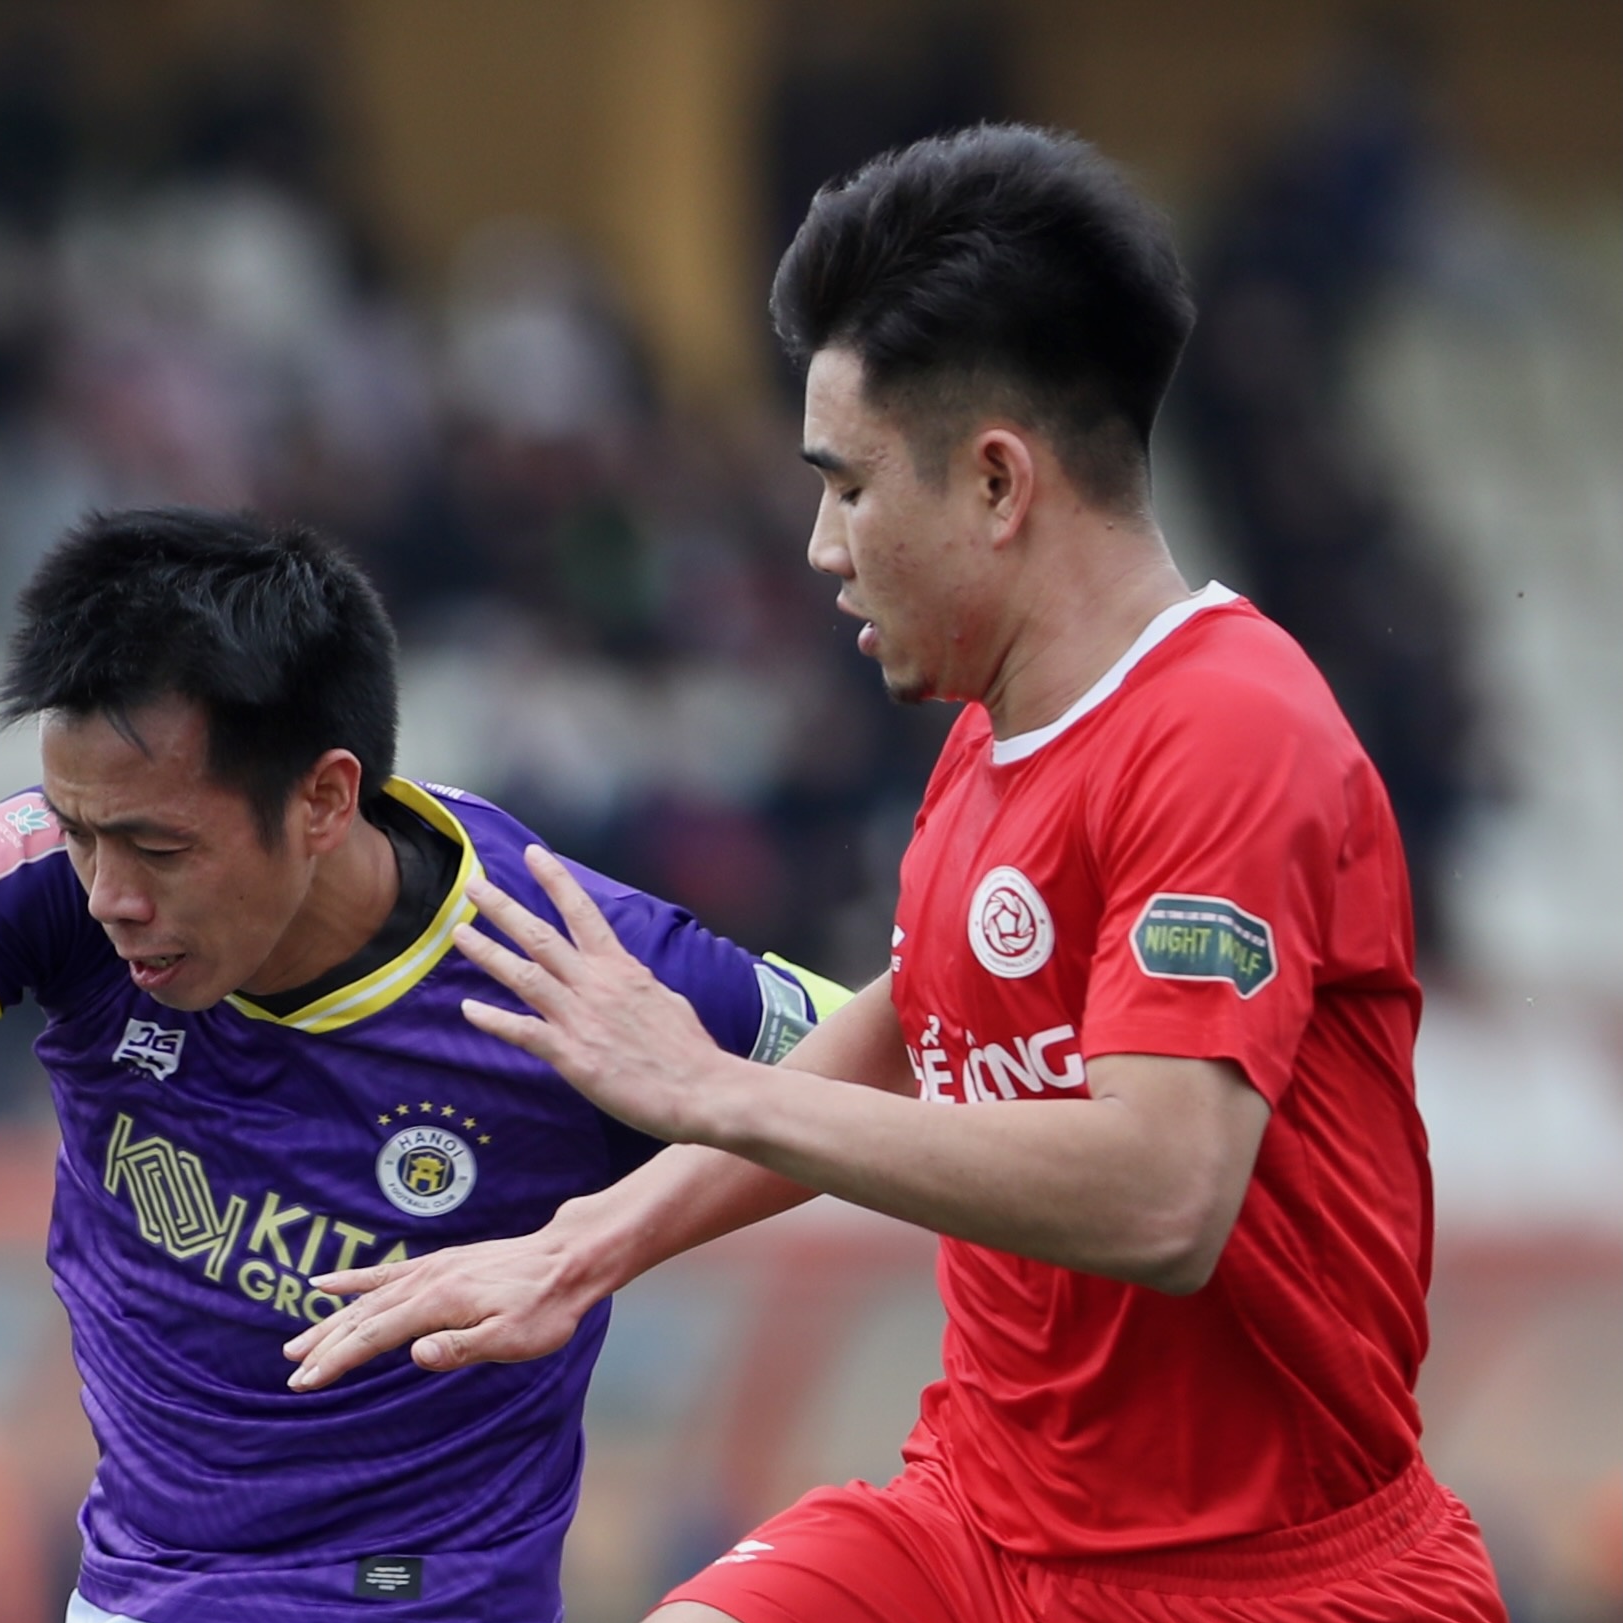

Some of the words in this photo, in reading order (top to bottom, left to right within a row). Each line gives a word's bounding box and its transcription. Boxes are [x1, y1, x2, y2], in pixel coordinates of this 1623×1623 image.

[1145, 924, 1212, 958] NIGHT
[397, 1131, 465, 1158] HANOI
[238, 1260, 356, 1324] GRO
